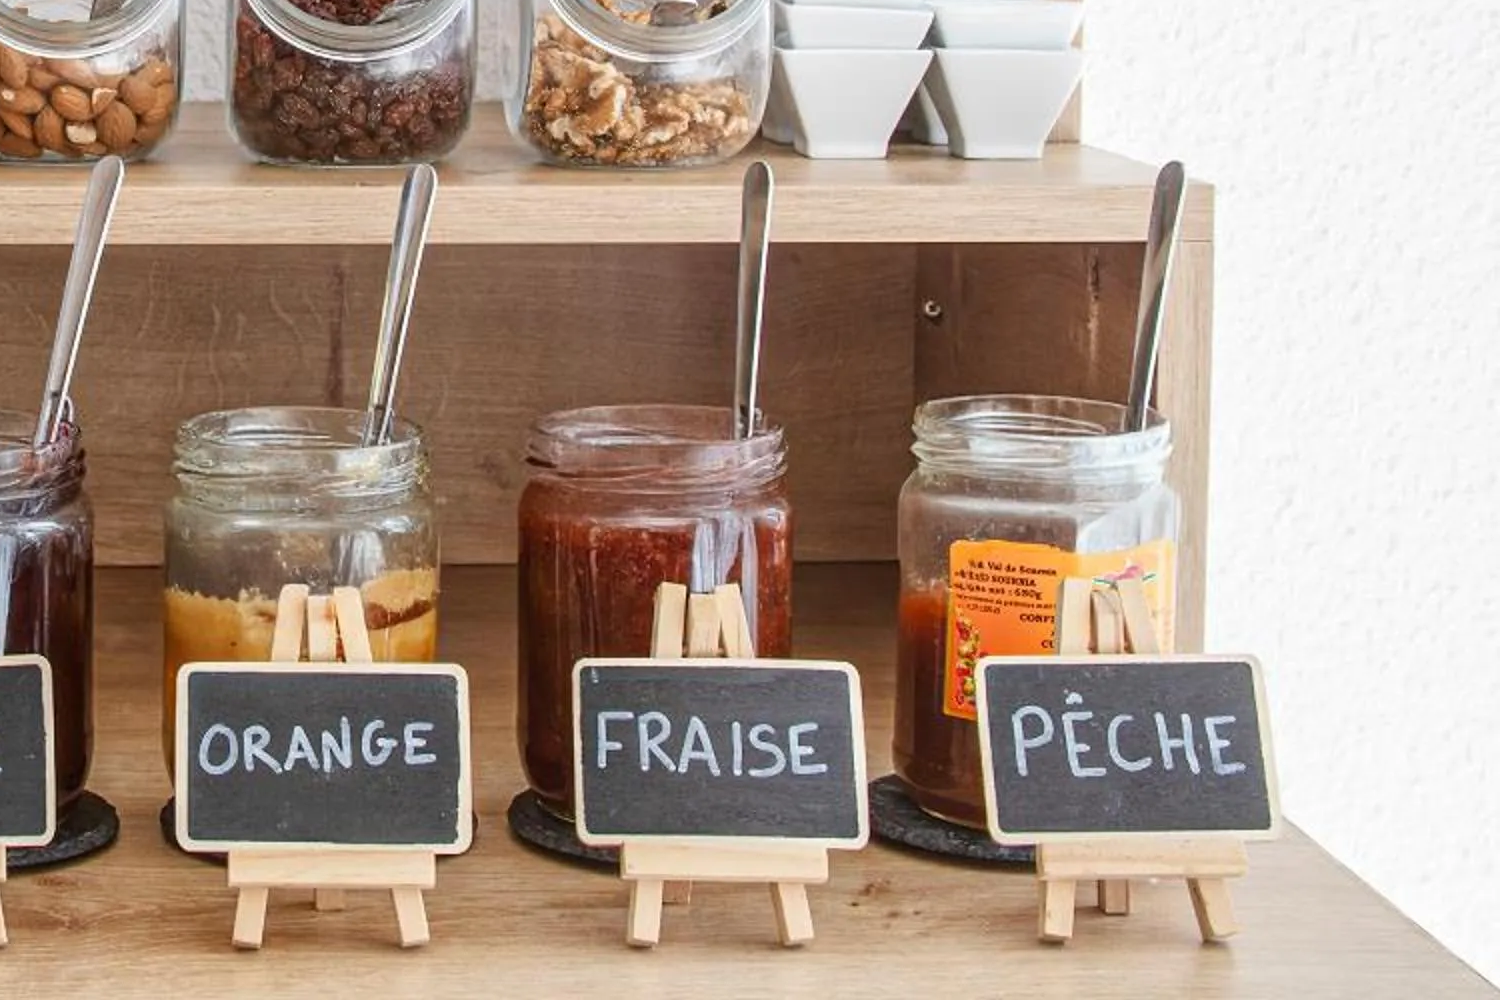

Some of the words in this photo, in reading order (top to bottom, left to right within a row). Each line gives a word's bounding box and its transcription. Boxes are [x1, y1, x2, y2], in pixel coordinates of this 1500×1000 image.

[199, 716, 437, 775] ORANGE
[597, 711, 828, 778] FRAISE
[1011, 691, 1246, 778] PÊCHE
